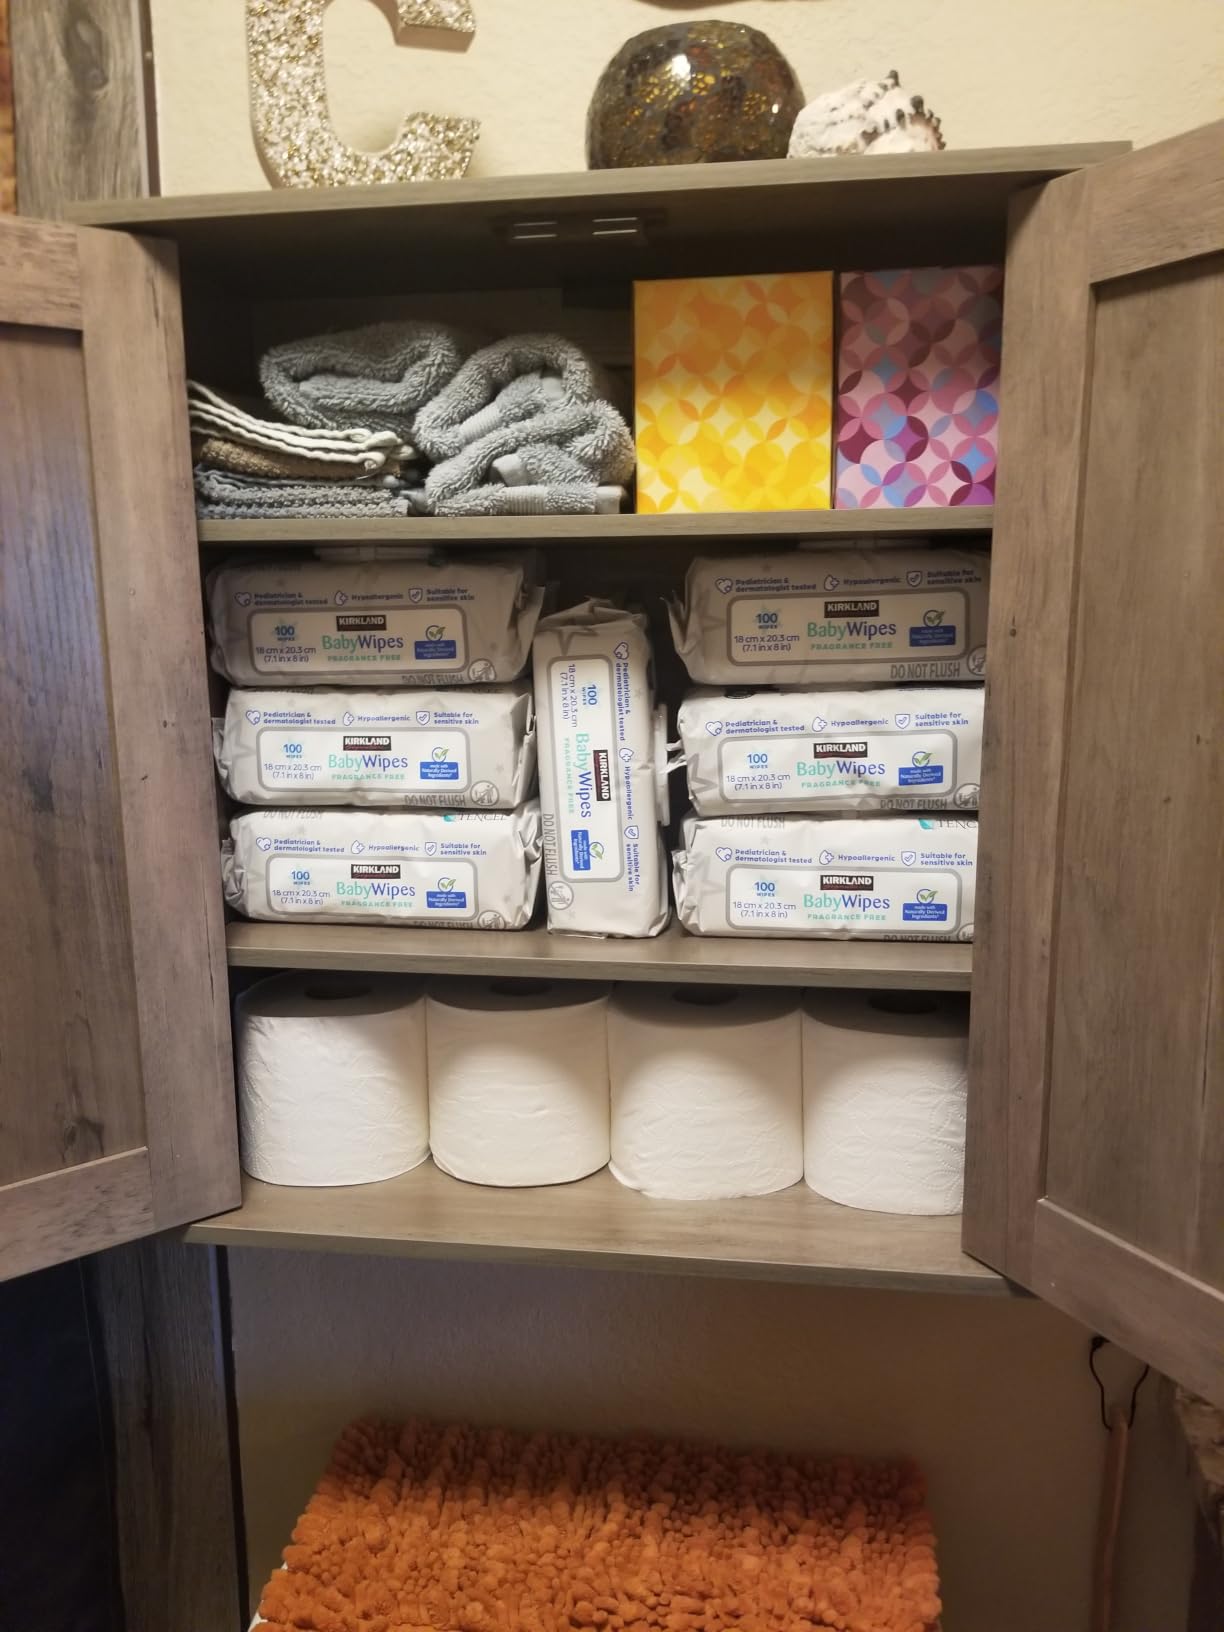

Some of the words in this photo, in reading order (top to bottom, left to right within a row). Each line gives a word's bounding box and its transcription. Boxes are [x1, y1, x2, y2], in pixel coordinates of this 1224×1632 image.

[245, 0, 481, 189] C
[827, 602, 877, 612] KIRKLAND
[339, 617, 385, 625] KIRKLAND
[756, 613, 778, 624] 100
[275, 625, 295, 636] 100
[807, 620, 897, 640] BabyWipes
[322, 634, 404, 653] BabyWipes
[742, 644, 757, 653] (7.1
[781, 643, 791, 651] in)
[810, 642, 866, 650] FRAGRANCE
[870, 641, 893, 649] FREE
[568, 664, 576, 673] 18
[890, 664, 905, 679] DO
[907, 663, 928, 678] NOT
[930, 662, 960, 678] FLUSH
[569, 674, 576, 688] cm
[616, 663, 624, 715] dermatologist
[587, 684, 597, 705] 100
[571, 716, 577, 728] cm
[831, 718, 889, 727] Hypoallergenic
[725, 726, 779, 734] dermatologist
[344, 737, 390, 745] KIRKLAND
[283, 744, 303, 753] 100
[816, 744, 866, 752] KIRKLAND
[328, 754, 408, 772] BabyWipes
[747, 753, 768, 764] 100
[796, 760, 885, 778] BabyWipes
[273, 771, 286, 780] (7.1
[305, 772, 315, 780] in)
[574, 733, 592, 818] BabyWipes
[599, 752, 609, 800] KIRKLAND
[734, 783, 749, 791] (7.1
[772, 782, 782, 790] in)
[801, 780, 857, 788] FRAGRANCE
[859, 779, 881, 787] FREE
[624, 766, 633, 820] Hypoallergenic
[404, 795, 421, 805] DO
[422, 795, 438, 805] NOT
[440, 795, 466, 806] FLUSH
[895, 799, 915, 809] NOT
[917, 799, 948, 809] FLUSH
[543, 814, 554, 827] DO
[736, 817, 754, 828] NOT
[757, 817, 785, 829] FLUSH
[544, 828, 556, 845] NOT
[274, 845, 321, 853] dermatologist
[368, 844, 420, 852] Hypoallergenic
[545, 848, 558, 875] FLUSH
[735, 855, 787, 863] dermatologist
[838, 854, 896, 862] Hypoallergenic
[291, 870, 310, 880] 100
[823, 876, 872, 885] KIRKLAND
[336, 881, 416, 900] BabyWipes
[755, 882, 775, 892] 100
[280, 897, 294, 905] (7.1
[803, 893, 890, 912] BabyWipes
[740, 910, 755, 918] (7.1
[778, 911, 788, 919] in)
